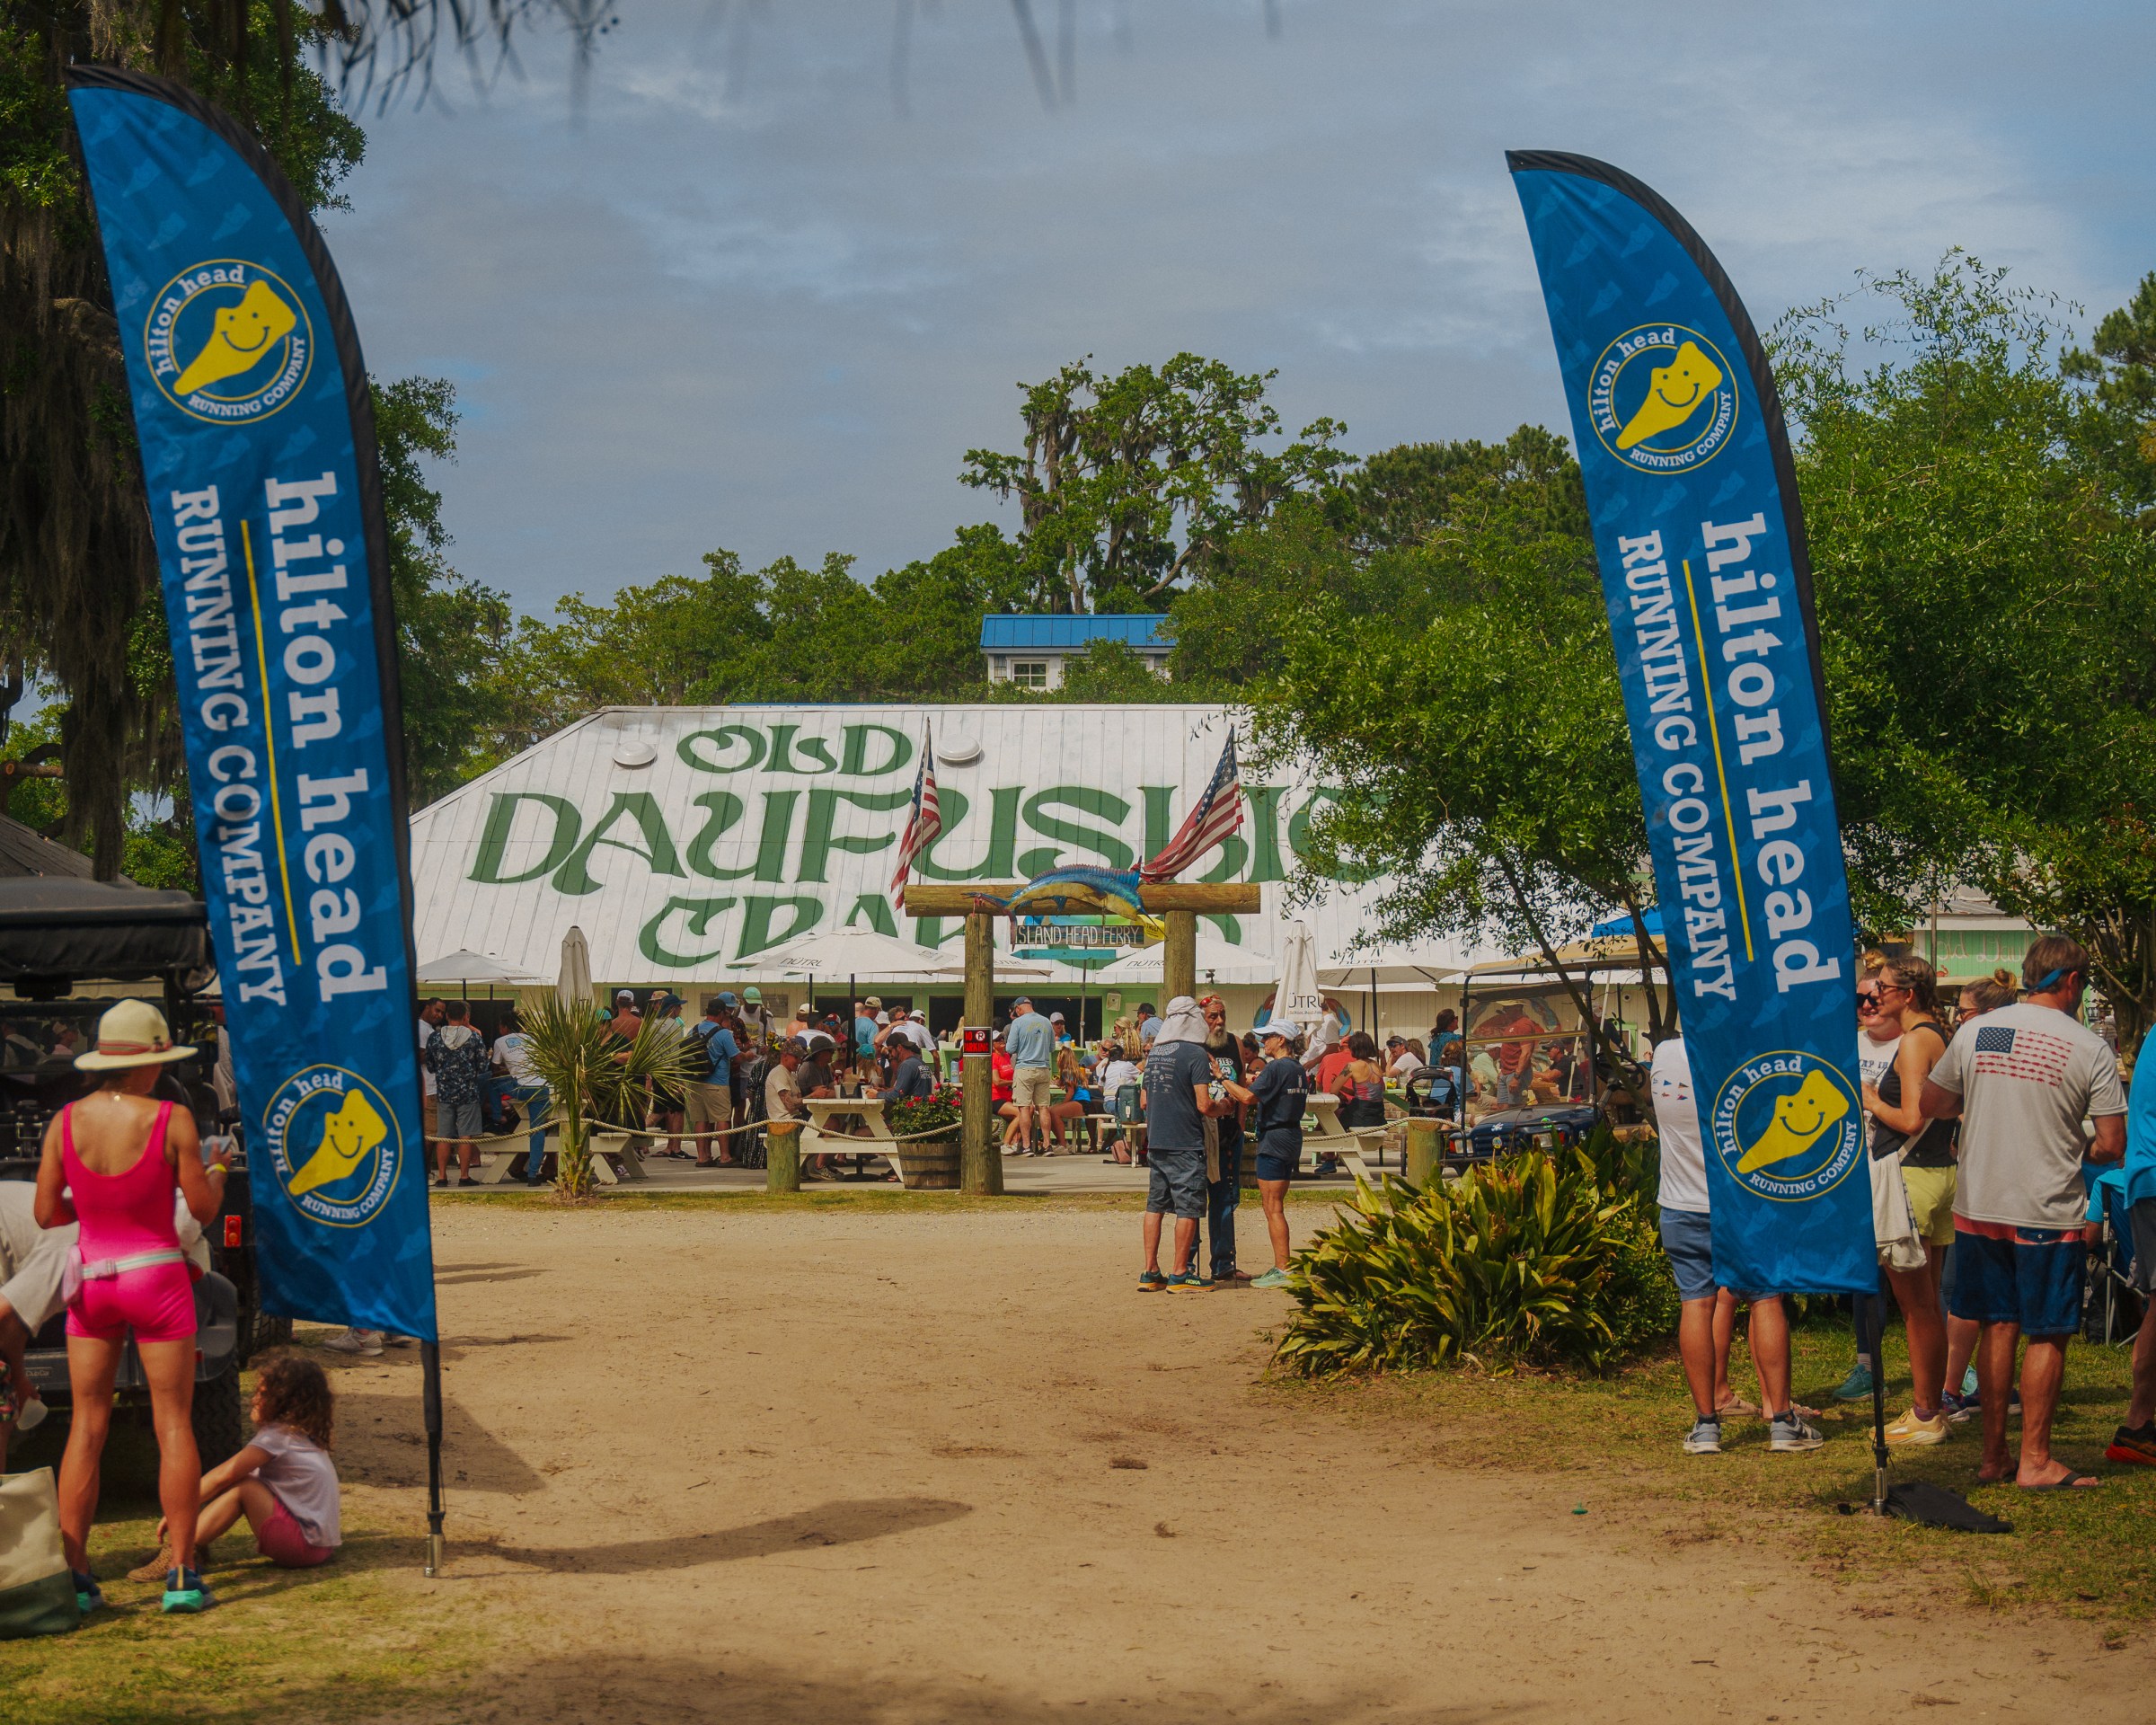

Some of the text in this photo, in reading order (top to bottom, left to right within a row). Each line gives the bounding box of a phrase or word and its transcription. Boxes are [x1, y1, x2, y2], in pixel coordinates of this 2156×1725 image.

[149, 264, 245, 376] hilton head
[188, 336, 305, 416] RUNNING COMPANY
[1593, 327, 1675, 433] hilton head
[1629, 391, 1731, 466] RUNNING COMPANY
[171, 484, 287, 1006] RUNNING COMPANY
[264, 471, 388, 1003] hilton head
[676, 724, 913, 776] OLD
[1618, 529, 1737, 1001] RUNNING COMPANY
[1701, 512, 1841, 993] hilton head
[1016, 924, 1140, 944] ISLAND HEAD FERRY
[293, 1071, 343, 1096] head
[1716, 1055, 1803, 1155] hilton head
[302, 1147, 394, 1219] RUNNING COMPANY
[1749, 1120, 1857, 1194] RUNNING COMPANY
